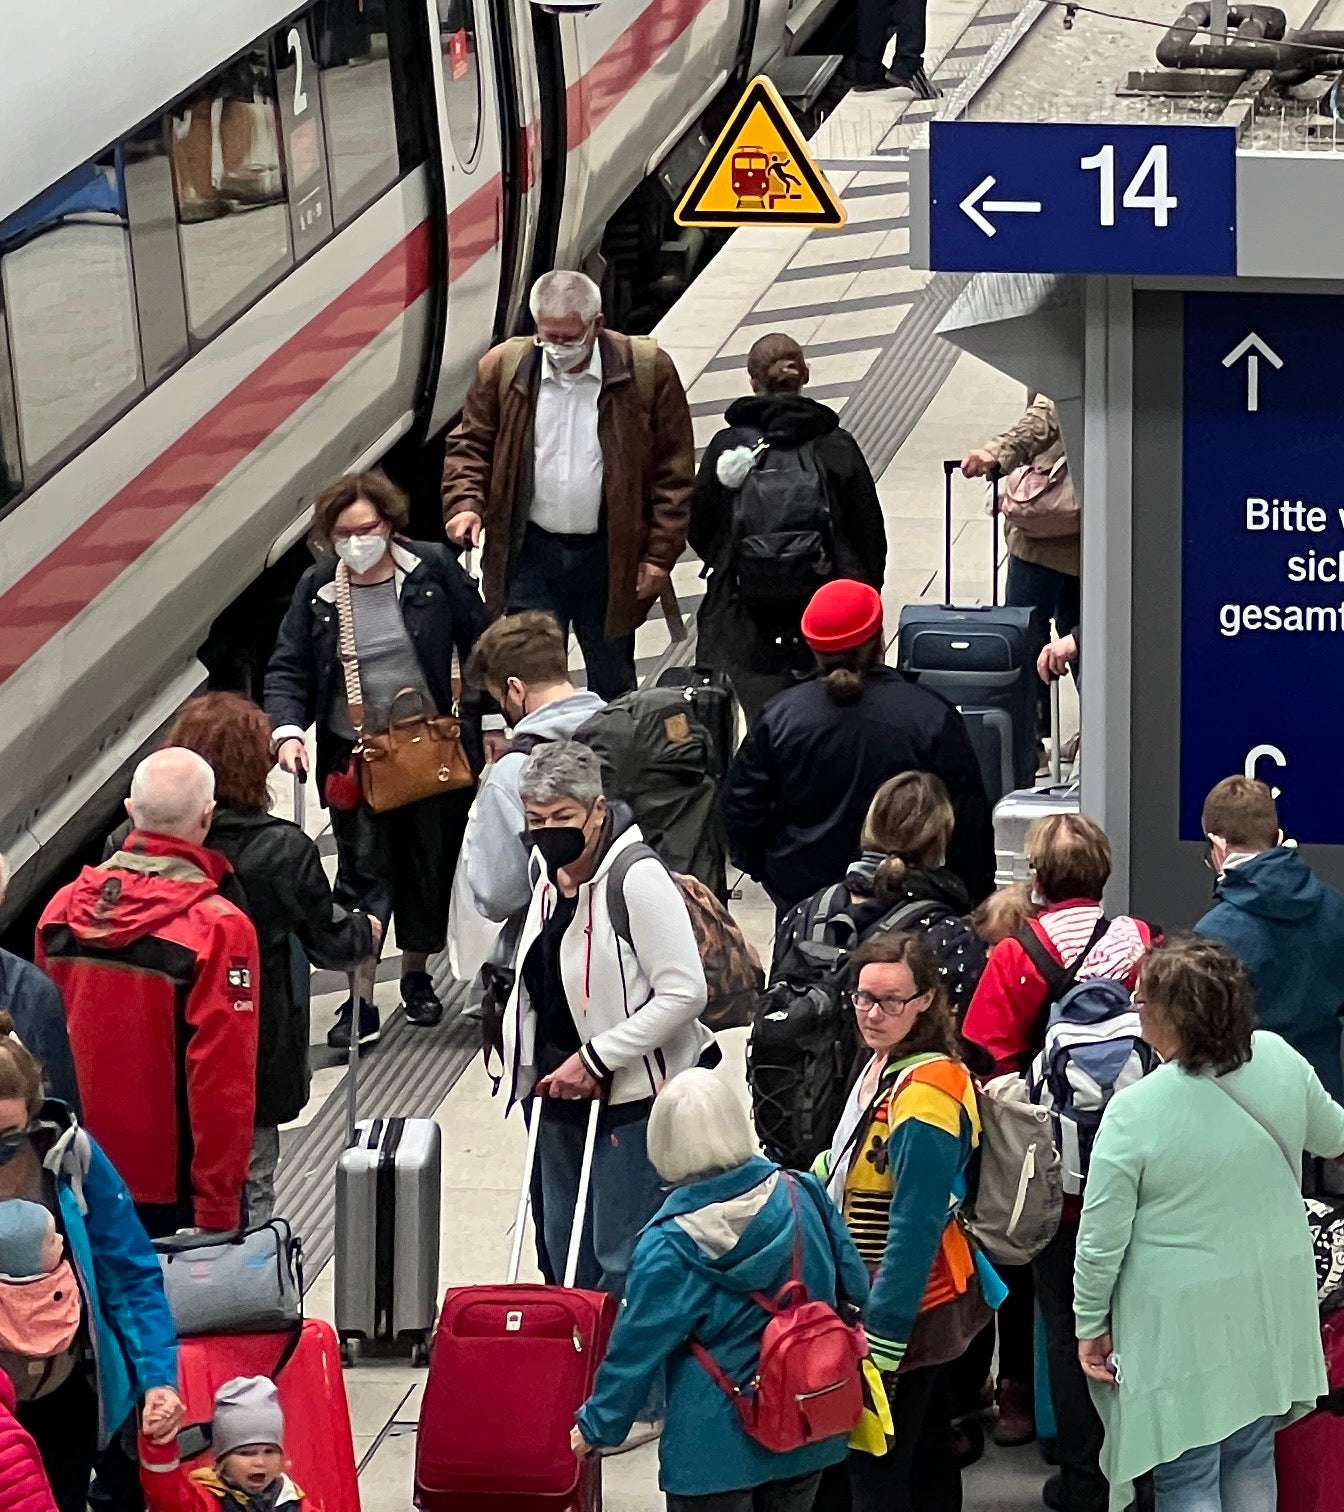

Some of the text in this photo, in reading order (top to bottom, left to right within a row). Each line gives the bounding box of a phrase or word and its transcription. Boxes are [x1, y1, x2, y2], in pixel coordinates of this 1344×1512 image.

[287, 28, 308, 117] 2
[1080, 144, 1178, 227] 14
[1245, 497, 1327, 532] Bitte
